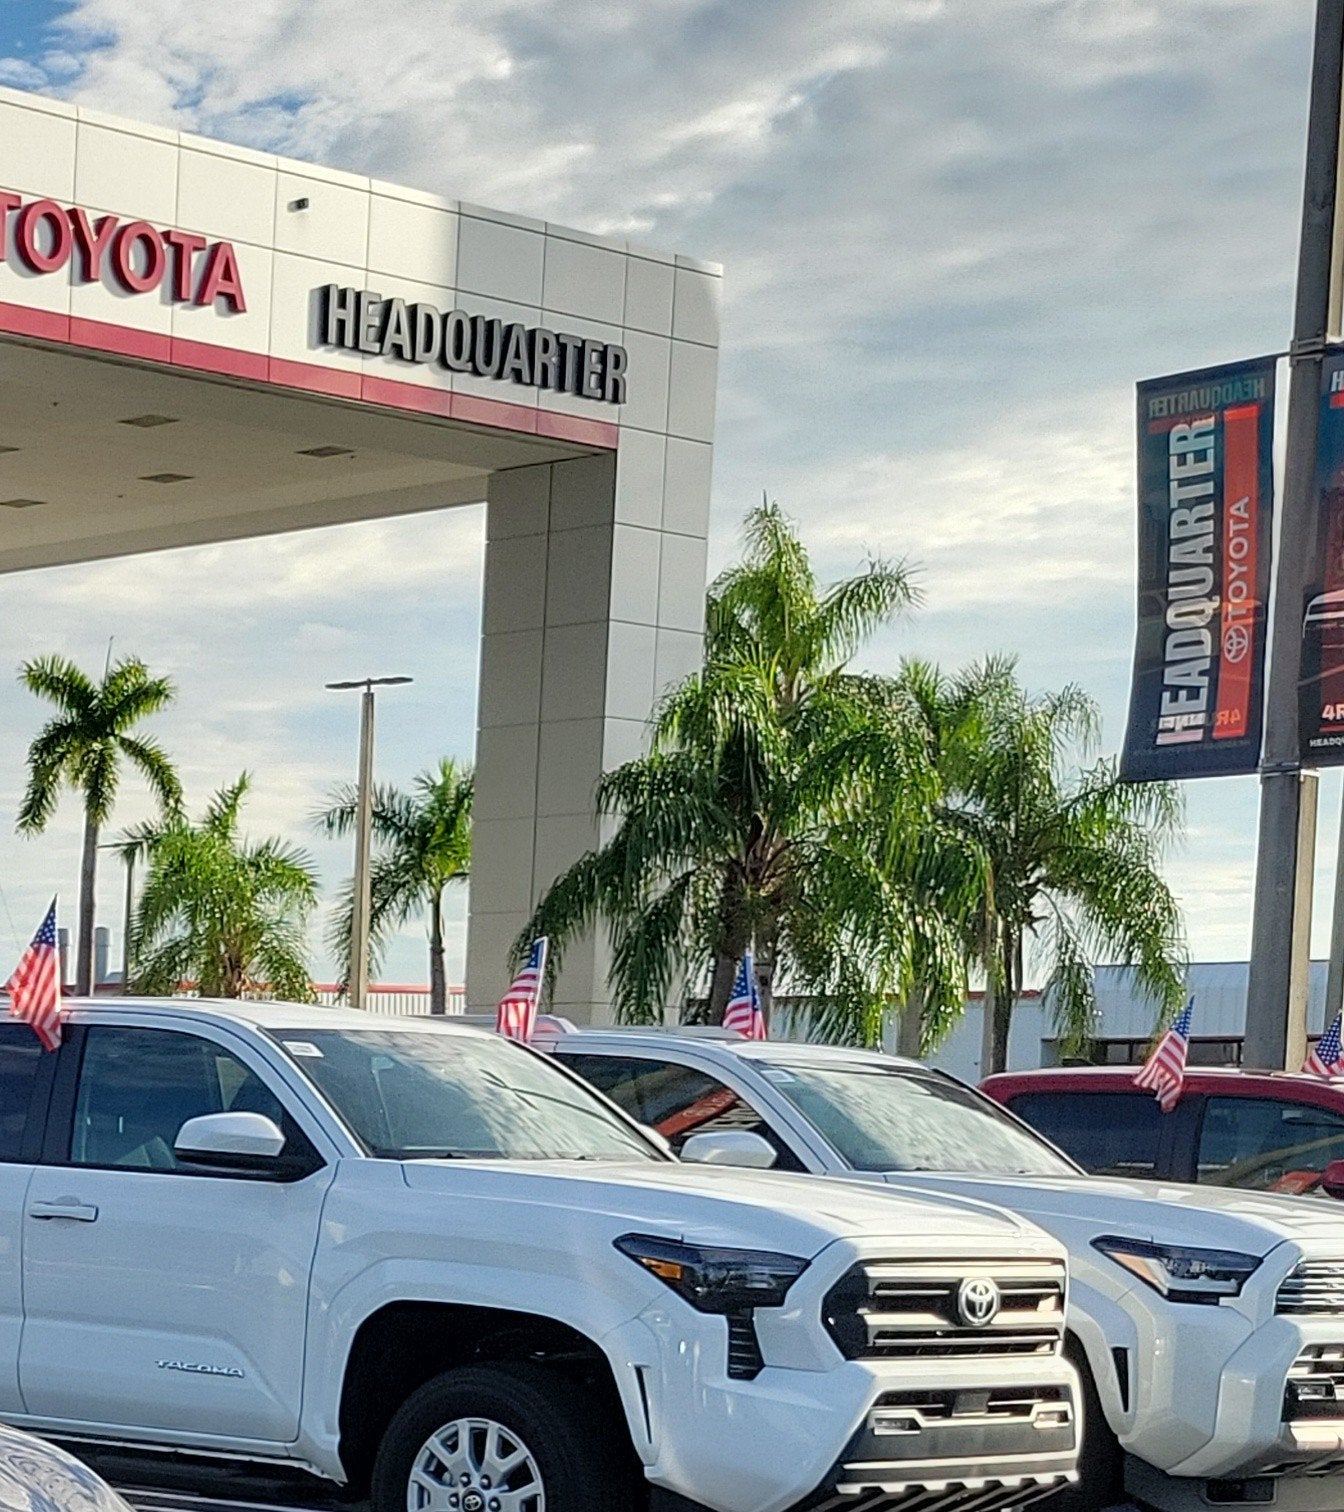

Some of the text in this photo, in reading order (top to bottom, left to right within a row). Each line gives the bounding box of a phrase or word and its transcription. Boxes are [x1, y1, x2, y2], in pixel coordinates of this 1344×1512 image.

[322, 283, 628, 405] HEADQUARTER
[1155, 416, 1219, 746] HEADQUARTER
[1226, 496, 1251, 617] TOYOTA
[155, 1359, 245, 1379] TACOMA
